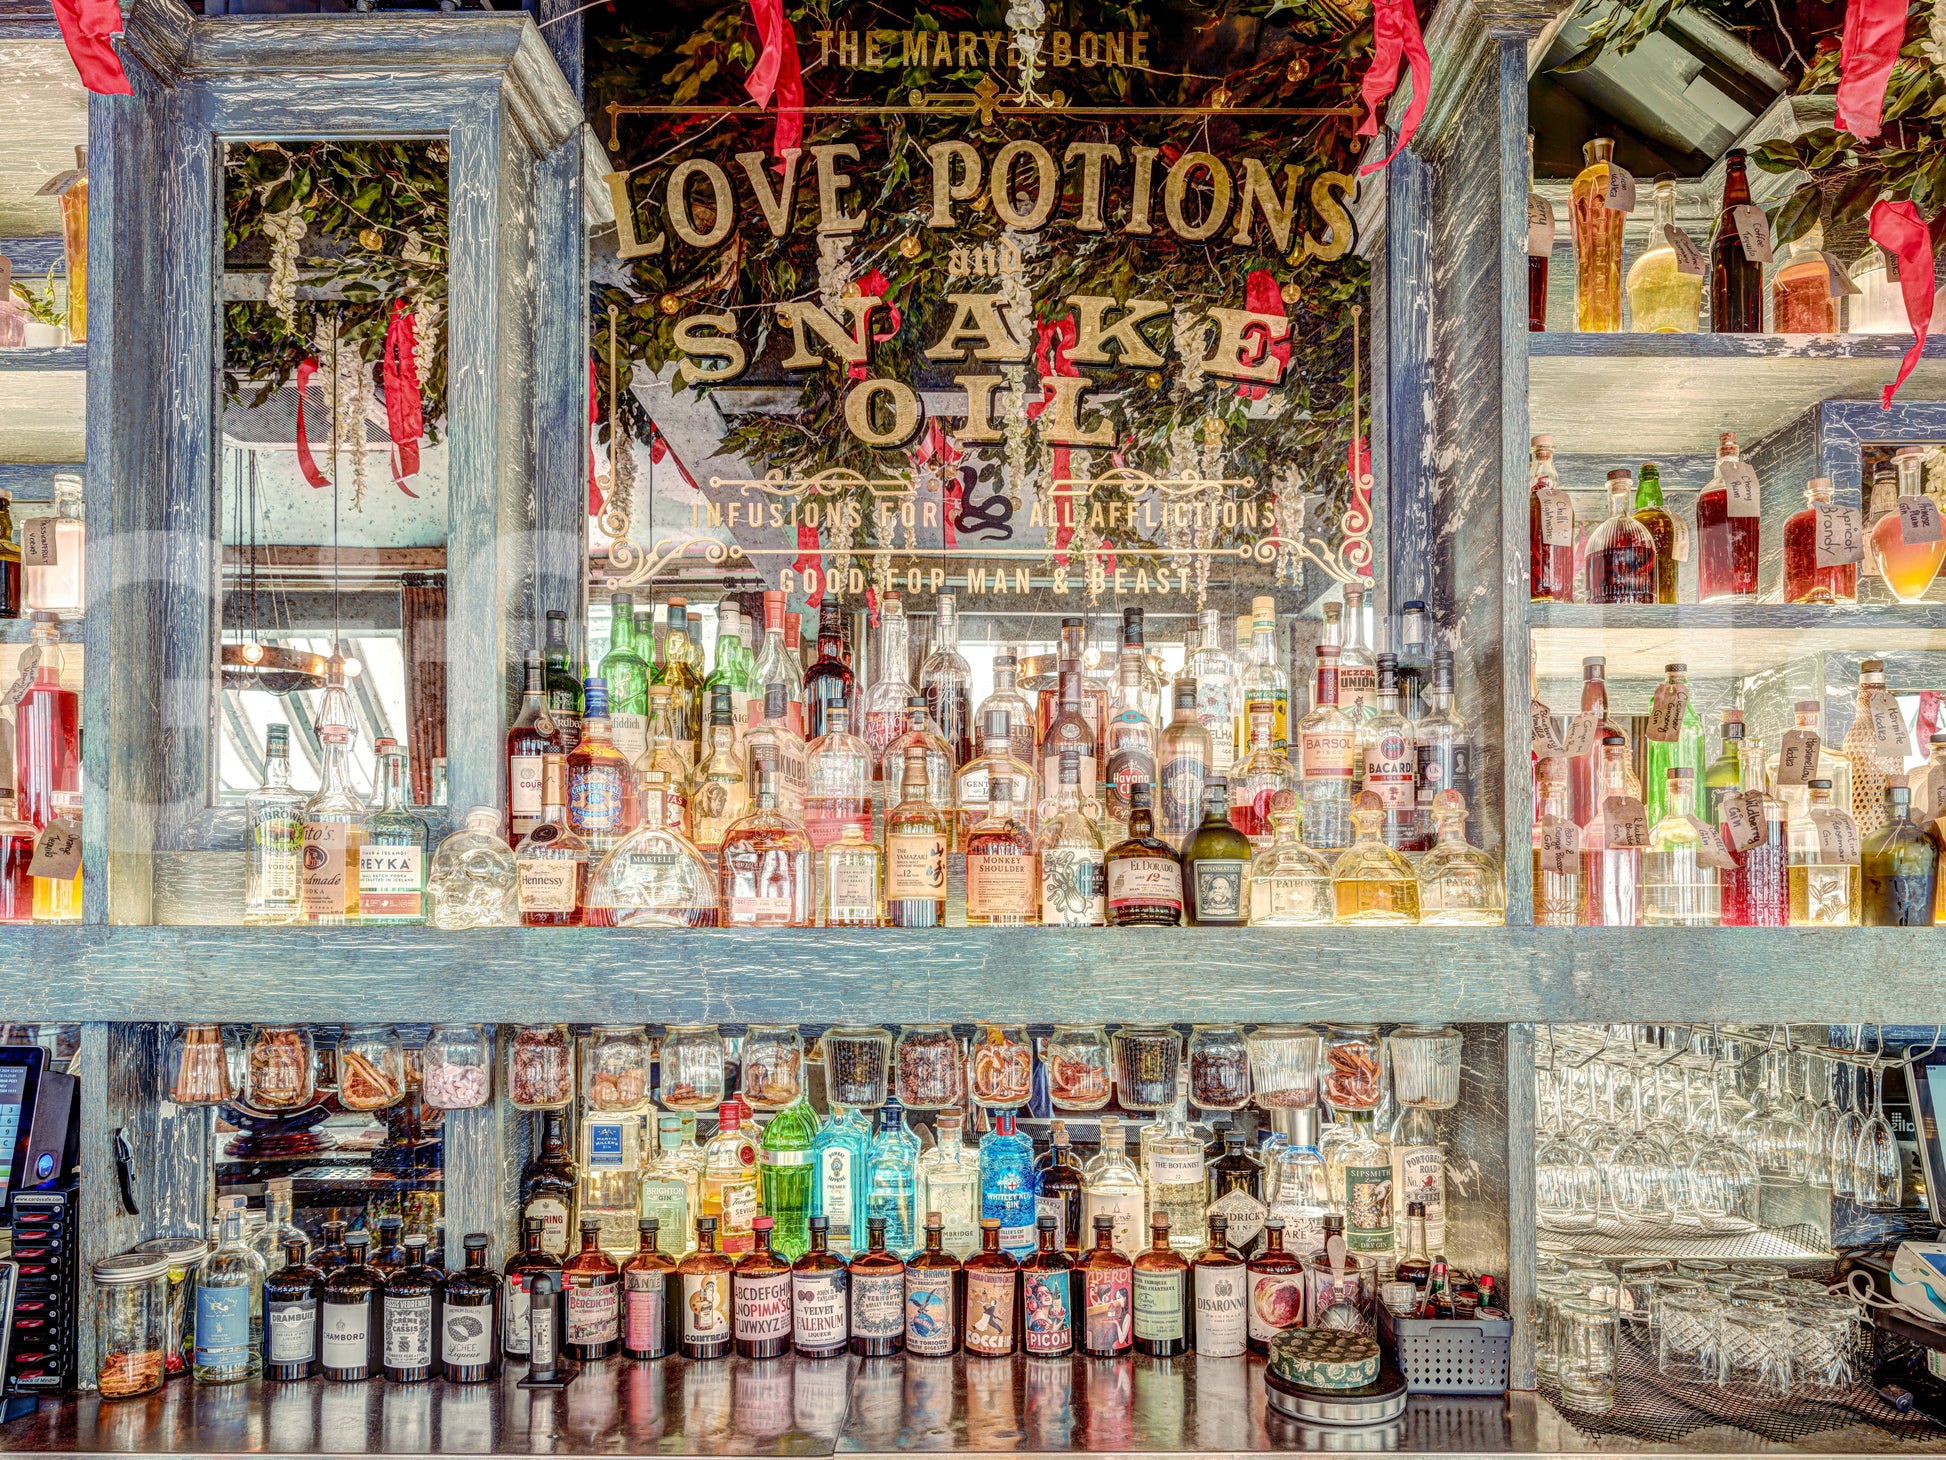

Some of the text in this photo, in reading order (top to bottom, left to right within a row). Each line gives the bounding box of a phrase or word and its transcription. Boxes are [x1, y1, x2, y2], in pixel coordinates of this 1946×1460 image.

[816, 30, 883, 67] THE
[602, 139, 1355, 260] LOVE POTIONS
[1752, 222, 1766, 248] Coffee
[1741, 231, 1754, 257] Tequila
[948, 236, 1023, 277] and
[672, 294, 1291, 386] SNAKE
[845, 374, 1115, 447] OIL
[1740, 475, 1752, 502] Cherry
[692, 501, 1277, 529] INFUSIONS FOR ALL AFFLICTIONS
[1541, 499, 1554, 541] Nightmare
[1555, 500, 1567, 524] Chilli
[1819, 505, 1838, 556] Brandy
[1841, 507, 1858, 553] Apricot
[780, 567, 1192, 595] GOOD FOR MAN & BEAST
[1341, 675, 1376, 688] UNIÓN
[1652, 709, 1663, 725] Gin
[1659, 702, 1674, 733] Ginseng
[1671, 690, 1688, 731] Cucumber
[611, 717, 640, 729] fiddich
[1874, 712, 1888, 741] Vodka
[1888, 707, 1905, 745] Marmite
[1306, 738, 1352, 749] BARSOL
[967, 780, 1020, 788] GENTN
[1113, 772, 1150, 783] Havana
[1730, 806, 1744, 828] Gin
[1613, 823, 1623, 841] Gin
[1822, 829, 1832, 847] Gin
[44, 834, 60, 859] Tequila
[61, 833, 79, 857] Orange
[1543, 834, 1552, 851] Gin
[361, 858, 410, 870] REYKA
[632, 855, 673, 863] MARTELL
[983, 856, 1021, 864] MONKEY
[1130, 860, 1174, 872] EL DORADO
[903, 869, 911, 877] 12
[979, 864, 1025, 873] SHOULDER
[303, 872, 342, 886] ndmade
[522, 874, 564, 887] Hennessy
[1146, 872, 1161, 882] 12
[1155, 1161, 1200, 1170] THE BOTANIST
[1350, 1169, 1392, 1178] SIPSMITH
[646, 1187, 684, 1195] BRIGHTON
[1006, 1200, 1019, 1209] GIN
[942, 1230, 974, 1238] MBRIDGE
[1284, 1230, 1308, 1240] ARE
[1087, 1267, 1132, 1285] APEROL
[803, 1305, 835, 1316] VELVET
[1197, 1296, 1246, 1312] DISARONNO
[271, 1311, 314, 1323] DRAMBUIE
[796, 1313, 844, 1331] FALERNUM
[392, 1325, 419, 1333] CASSIS
[685, 1331, 729, 1343] COINTREAU
[1029, 1330, 1068, 1346] PICON
